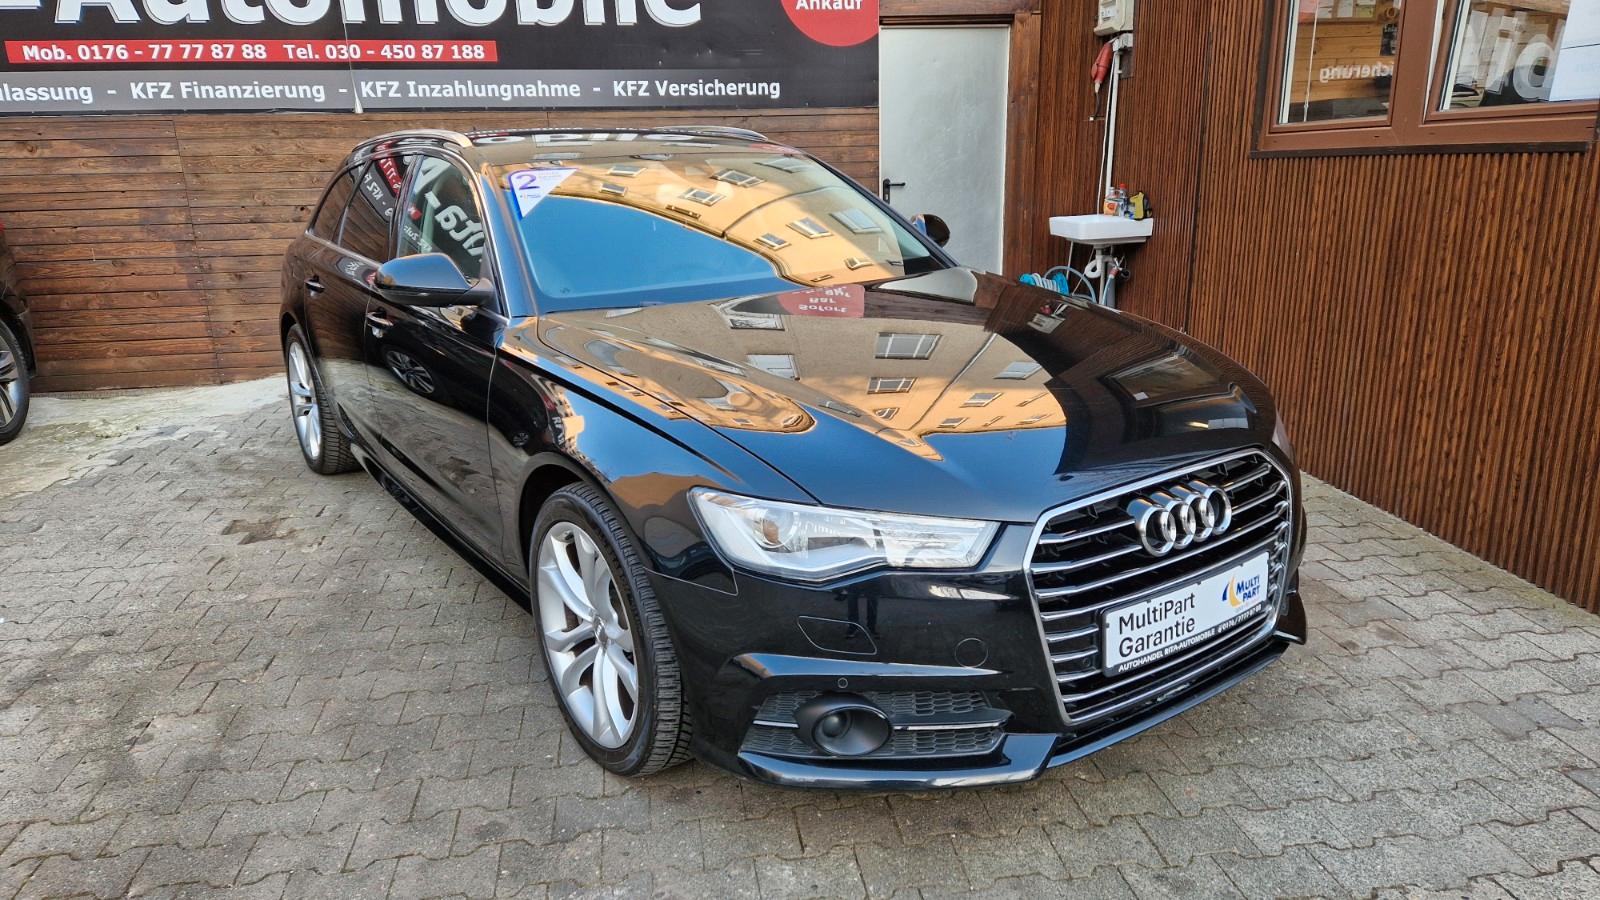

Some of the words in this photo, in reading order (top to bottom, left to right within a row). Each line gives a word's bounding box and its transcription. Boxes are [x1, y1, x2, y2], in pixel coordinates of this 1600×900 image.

[796, 0, 862, 10] Ankauf
[23, 45, 71, 60] Mob.
[78, 45, 128, 59] 0176
[149, 45, 172, 58] 77
[180, 45, 203, 58] 77
[211, 44, 234, 59] 87
[242, 44, 266, 59] 88
[283, 44, 319, 59] Tel.
[326, 45, 360, 59] 030
[381, 45, 415, 59] 450
[422, 45, 443, 59] 87
[452, 45, 484, 59] 188
[0, 83, 93, 104] lassung
[130, 82, 174, 99] KFZ
[180, 81, 325, 102] Finanzierung
[361, 81, 401, 98] KFZ
[407, 80, 580, 101] Inzahlungnahme
[614, 81, 649, 97] KFZ
[655, 80, 779, 98] Versicherung
[515, 173, 540, 190] 2
[1242, 585, 1260, 601] PART
[1118, 593, 1196, 635] MultiPart
[1118, 616, 1196, 658] Garantie
[1118, 651, 1164, 673] AUTOHANDEL
